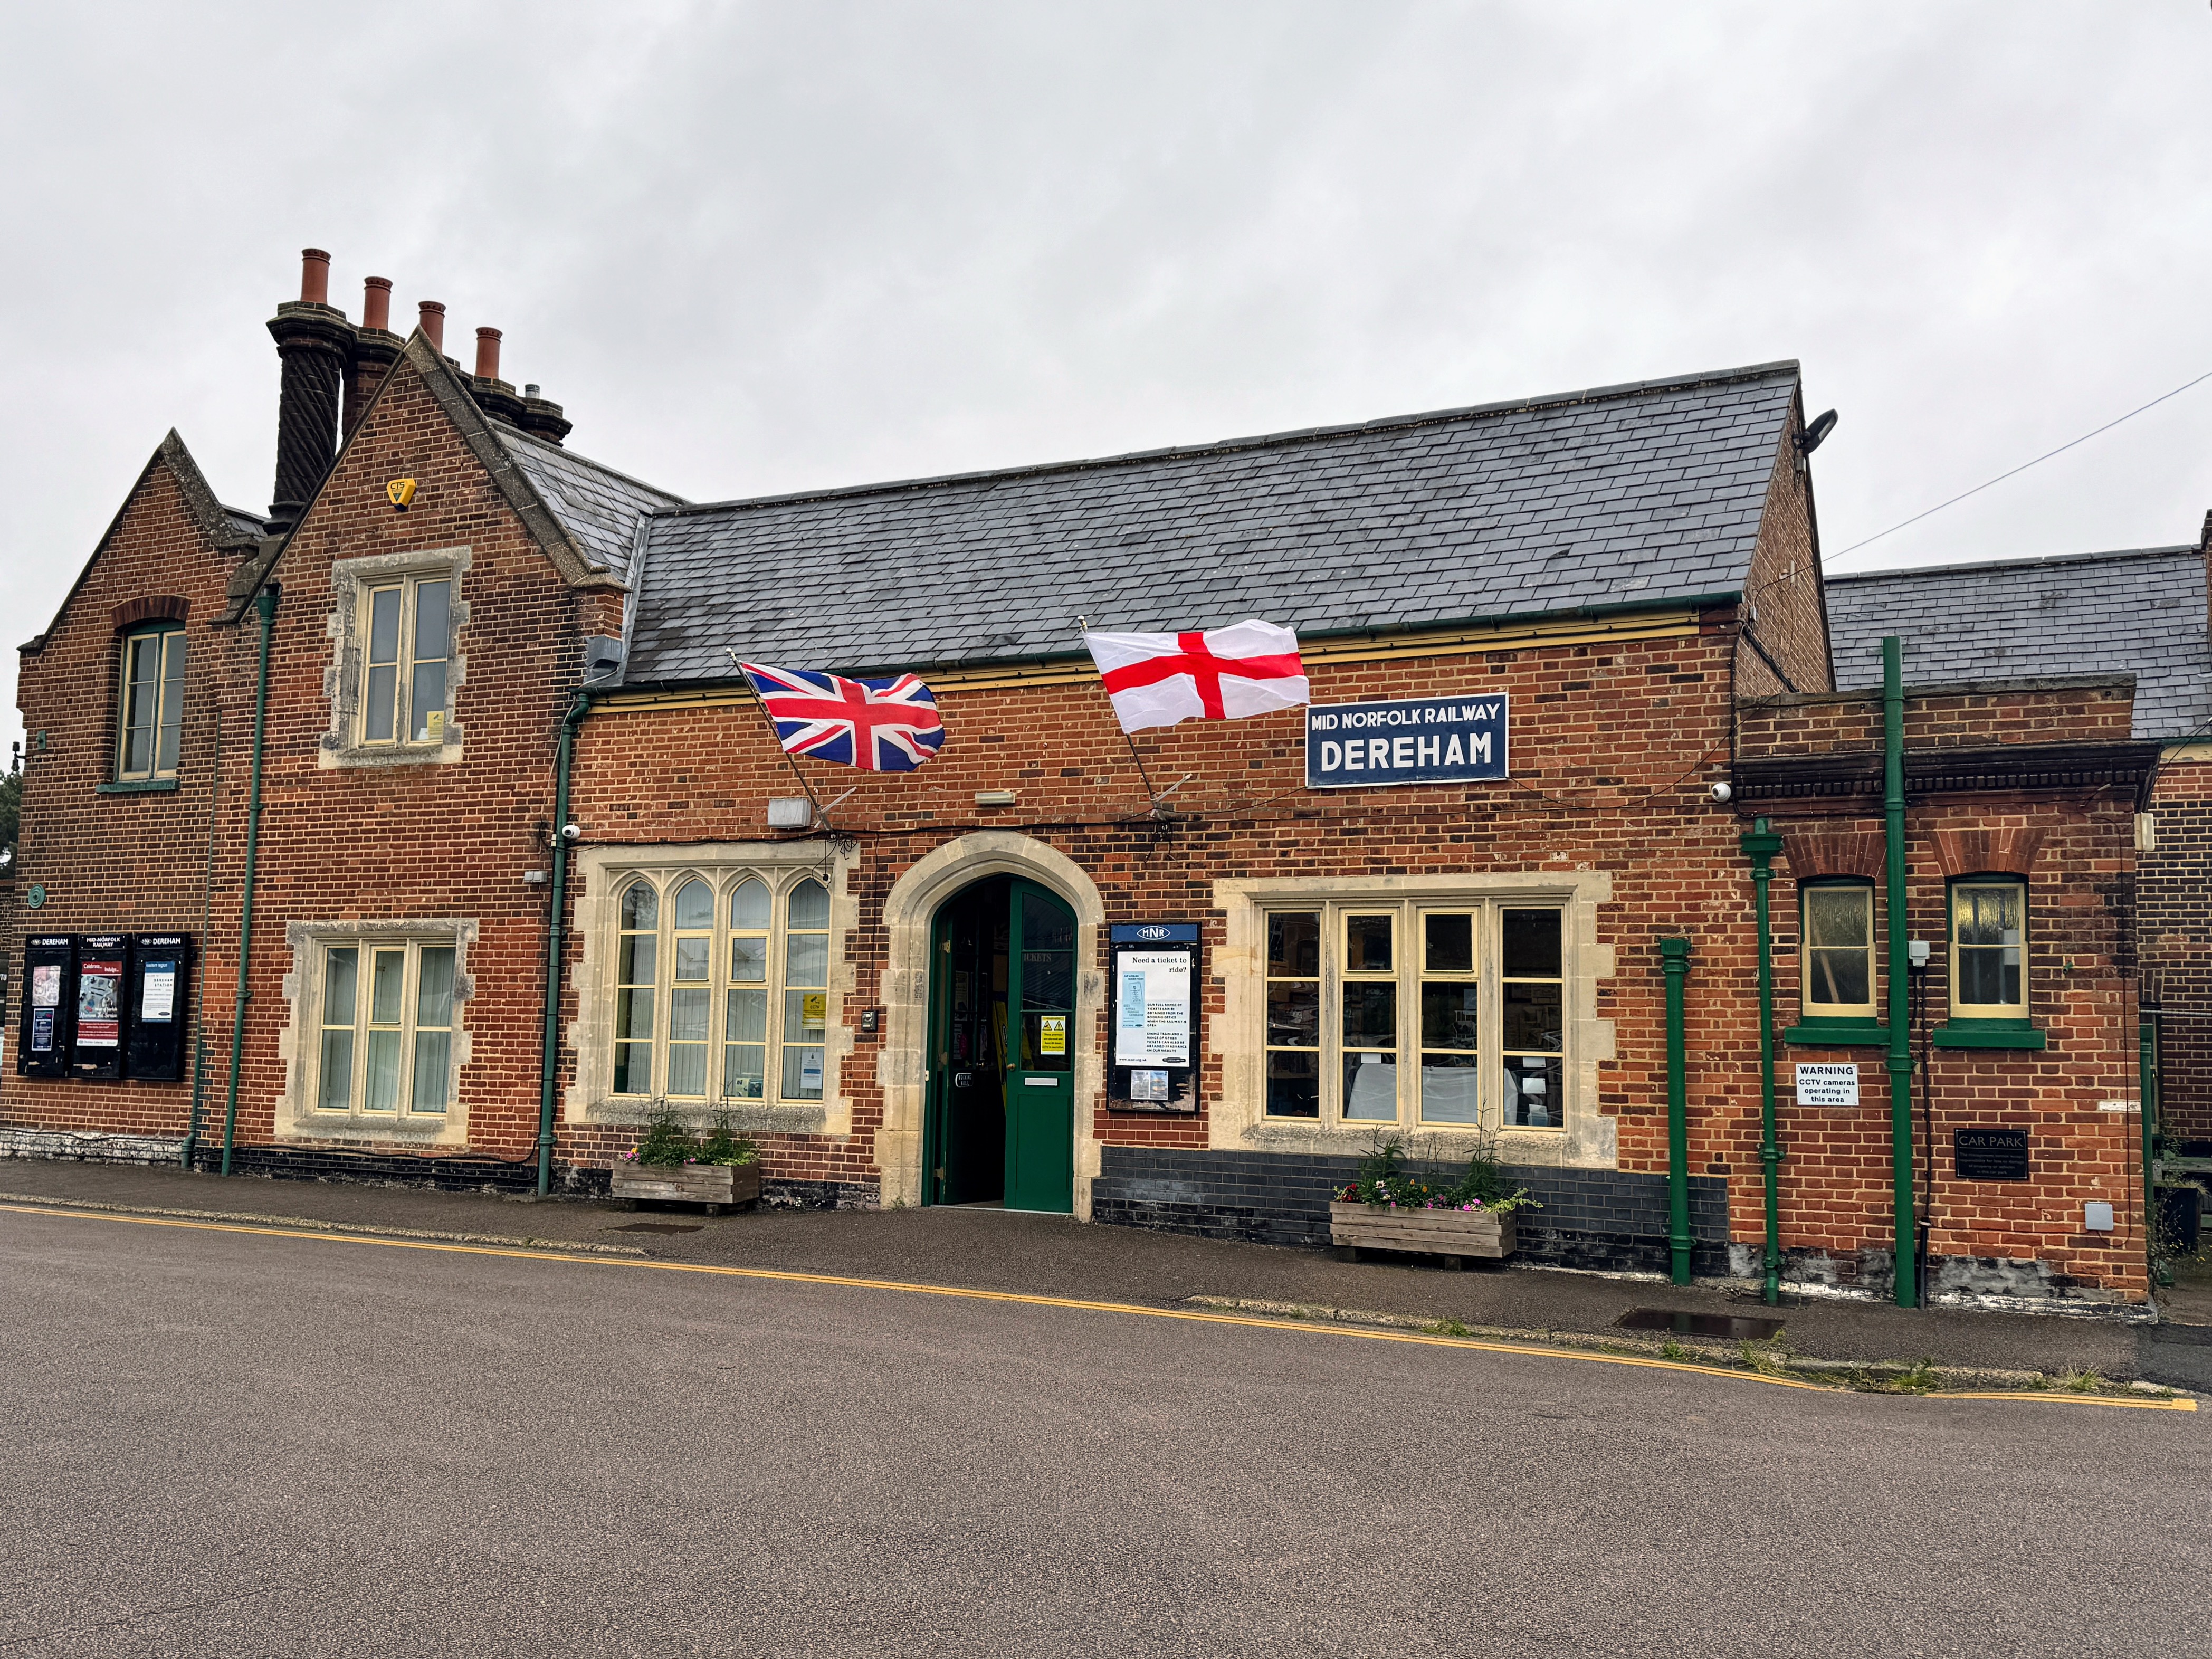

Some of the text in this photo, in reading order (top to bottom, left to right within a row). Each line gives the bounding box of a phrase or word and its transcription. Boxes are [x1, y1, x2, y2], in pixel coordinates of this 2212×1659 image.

[1311, 703, 1500, 731] MID NORFOLK RAILWAY
[1321, 732, 1491, 771] DEREHAM
[1143, 928, 1164, 938] MNR
[1024, 952, 1051, 962] ICKETS
[1959, 1136, 2024, 1147] CAR PARK
